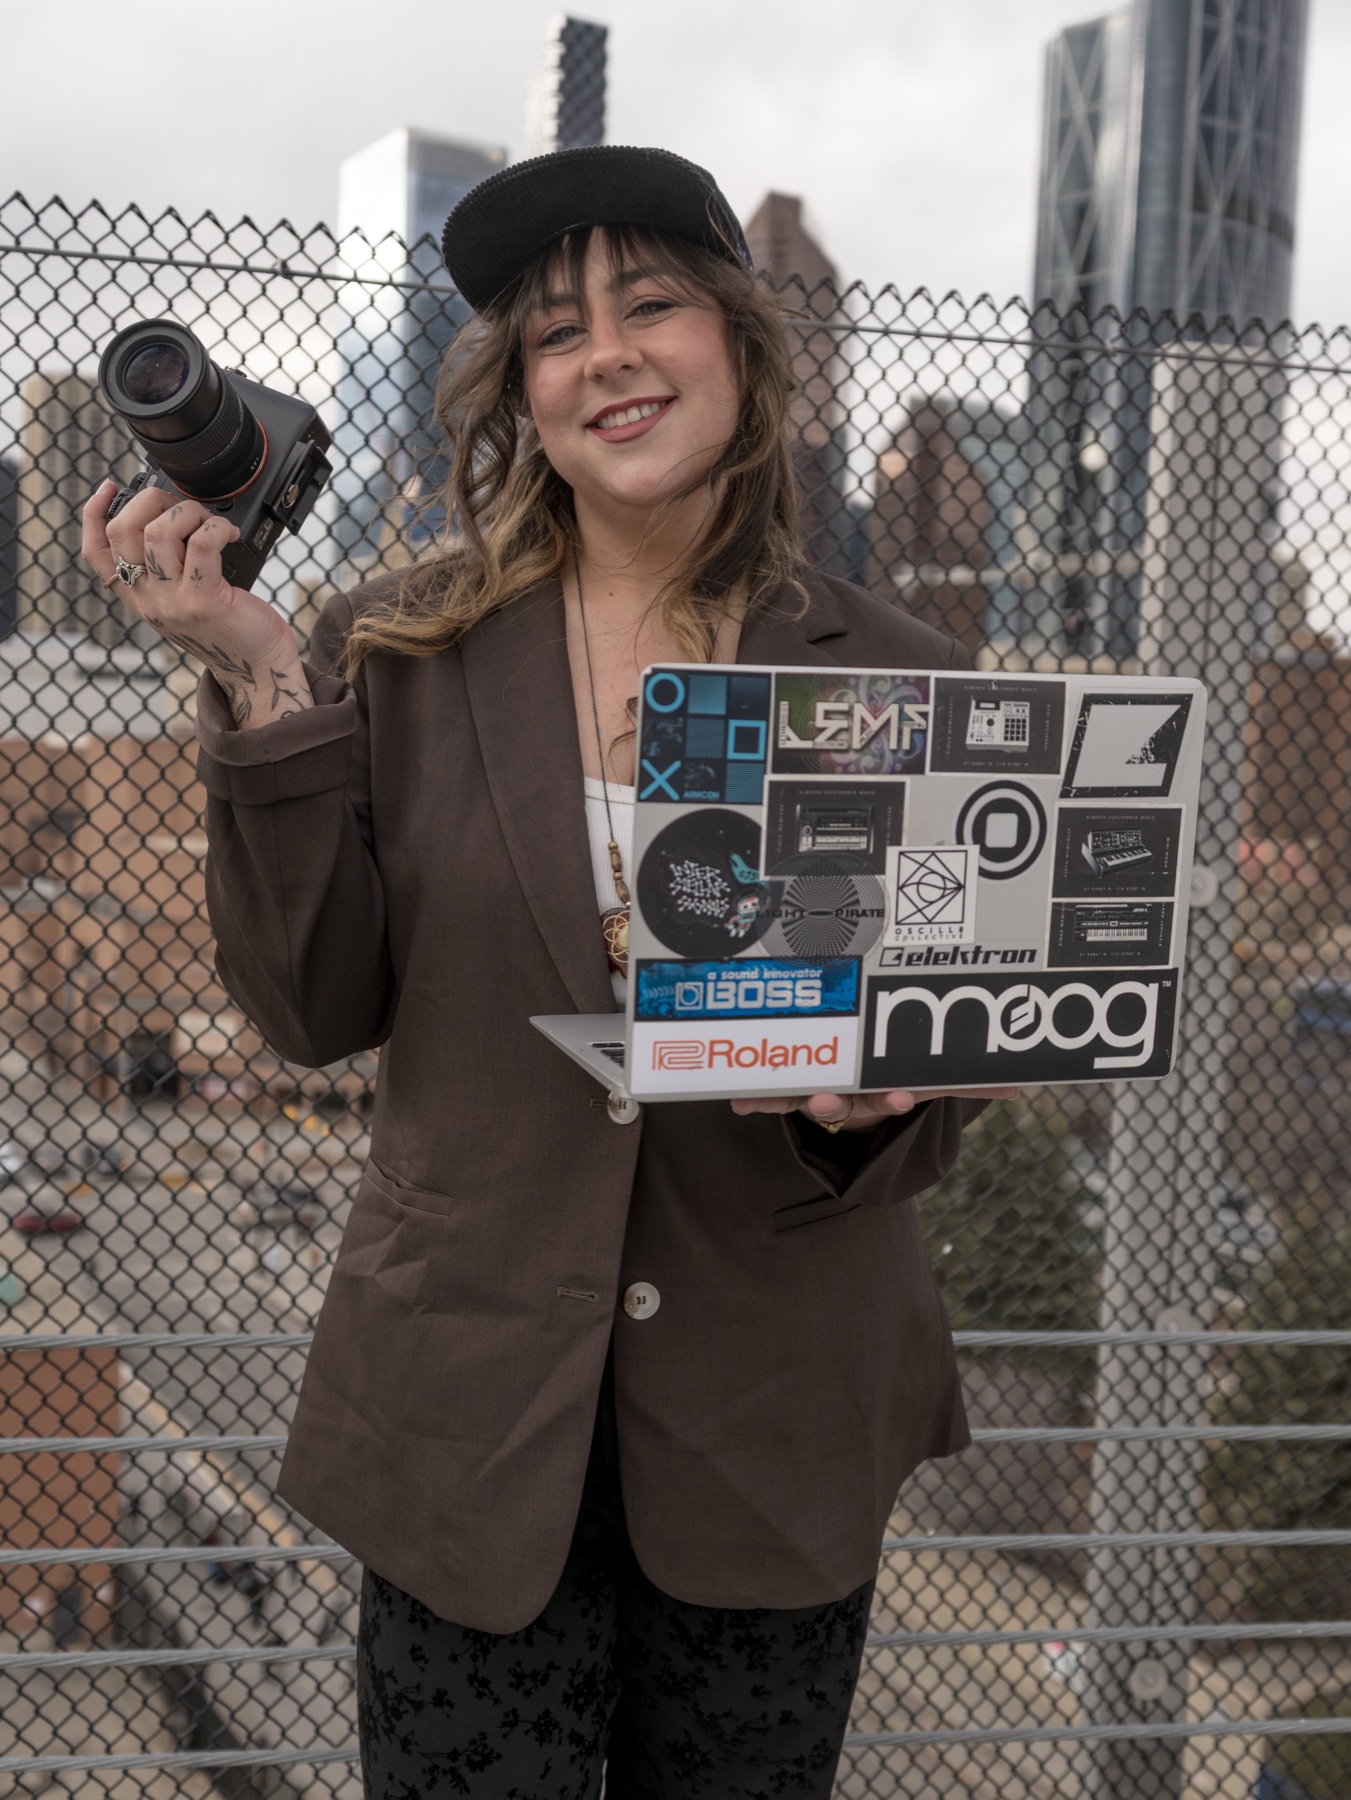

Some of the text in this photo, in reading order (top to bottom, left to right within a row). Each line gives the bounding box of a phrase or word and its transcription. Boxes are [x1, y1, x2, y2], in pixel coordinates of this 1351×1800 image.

[756, 908, 885, 919] LIGHT PIRATE
[904, 945, 1037, 967] elektron
[707, 968, 823, 981] a sound innovator
[706, 979, 822, 1009] BOSS
[873, 980, 1172, 1069] moog TM
[708, 1036, 839, 1069] Roland
